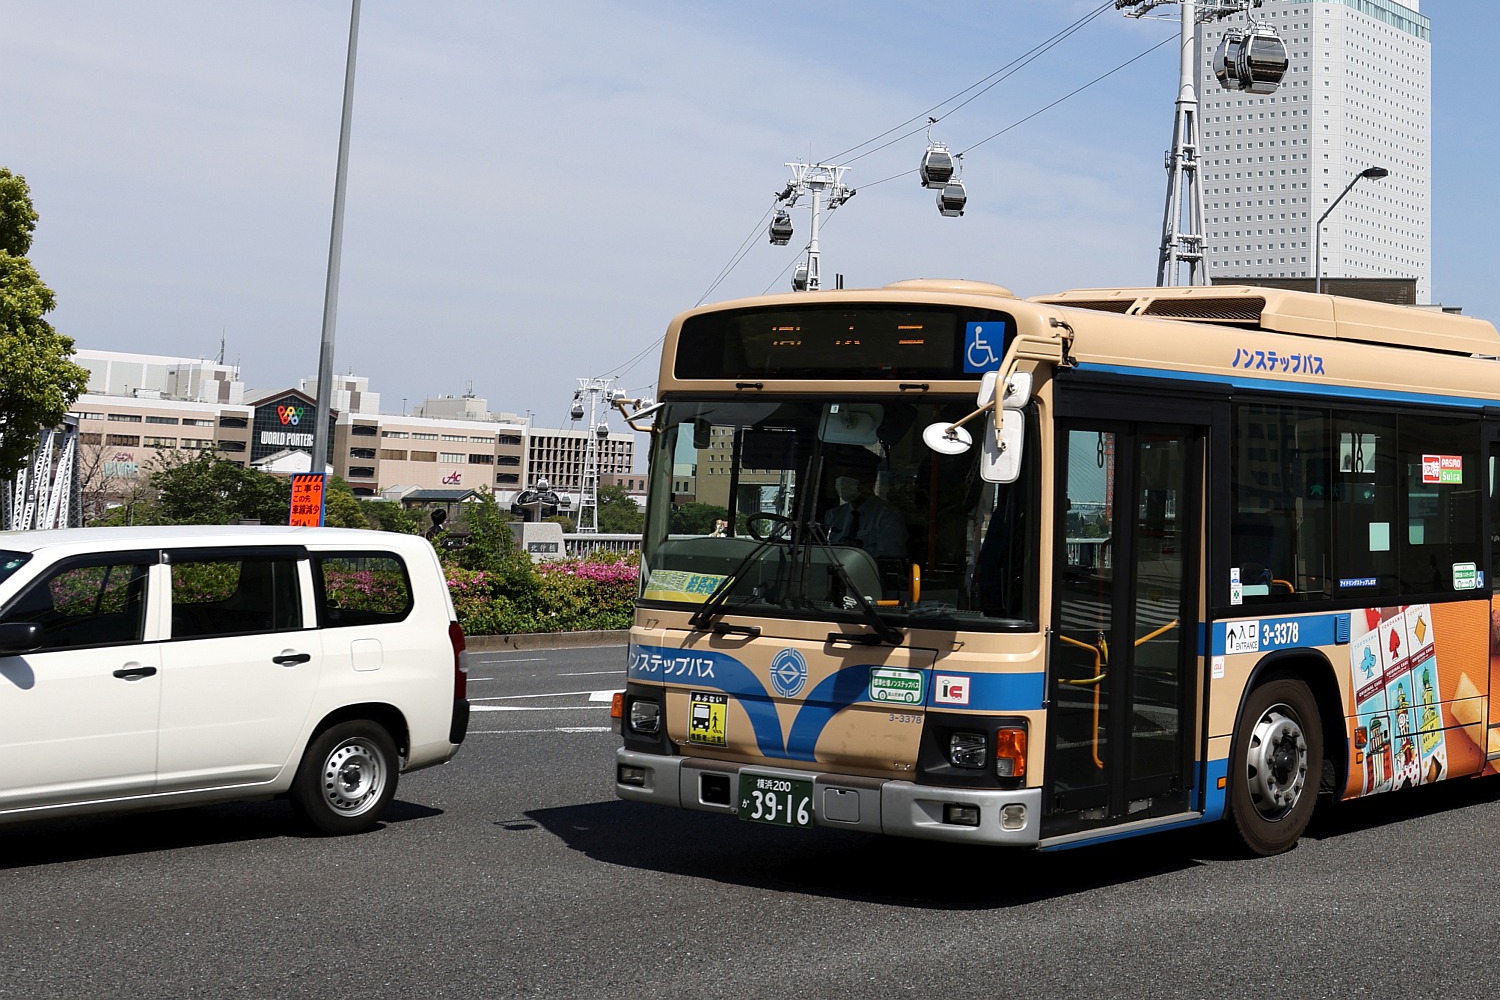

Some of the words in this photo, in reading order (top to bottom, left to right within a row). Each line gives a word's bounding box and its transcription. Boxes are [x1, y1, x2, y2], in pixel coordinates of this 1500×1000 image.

[1232, 348, 1325, 375] ノンステップバス
[260, 431, 285, 446] WORLD
[1441, 458, 1461, 468] PASMO
[1442, 471, 1460, 481] Suica
[294, 484, 320, 493] 工事中
[293, 495, 311, 503] この先
[292, 504, 320, 515] 車線減少
[1239, 624, 1256, 640] 入口
[1262, 622, 1299, 646] 3-3378
[1235, 640, 1258, 651] ENTRANCE
[628, 651, 715, 679] ンステップバス
[695, 693, 722, 703] あぶない
[888, 713, 922, 725] 3-3378
[757, 778, 792, 793] 横浜200
[751, 789, 810, 825] 39-16
